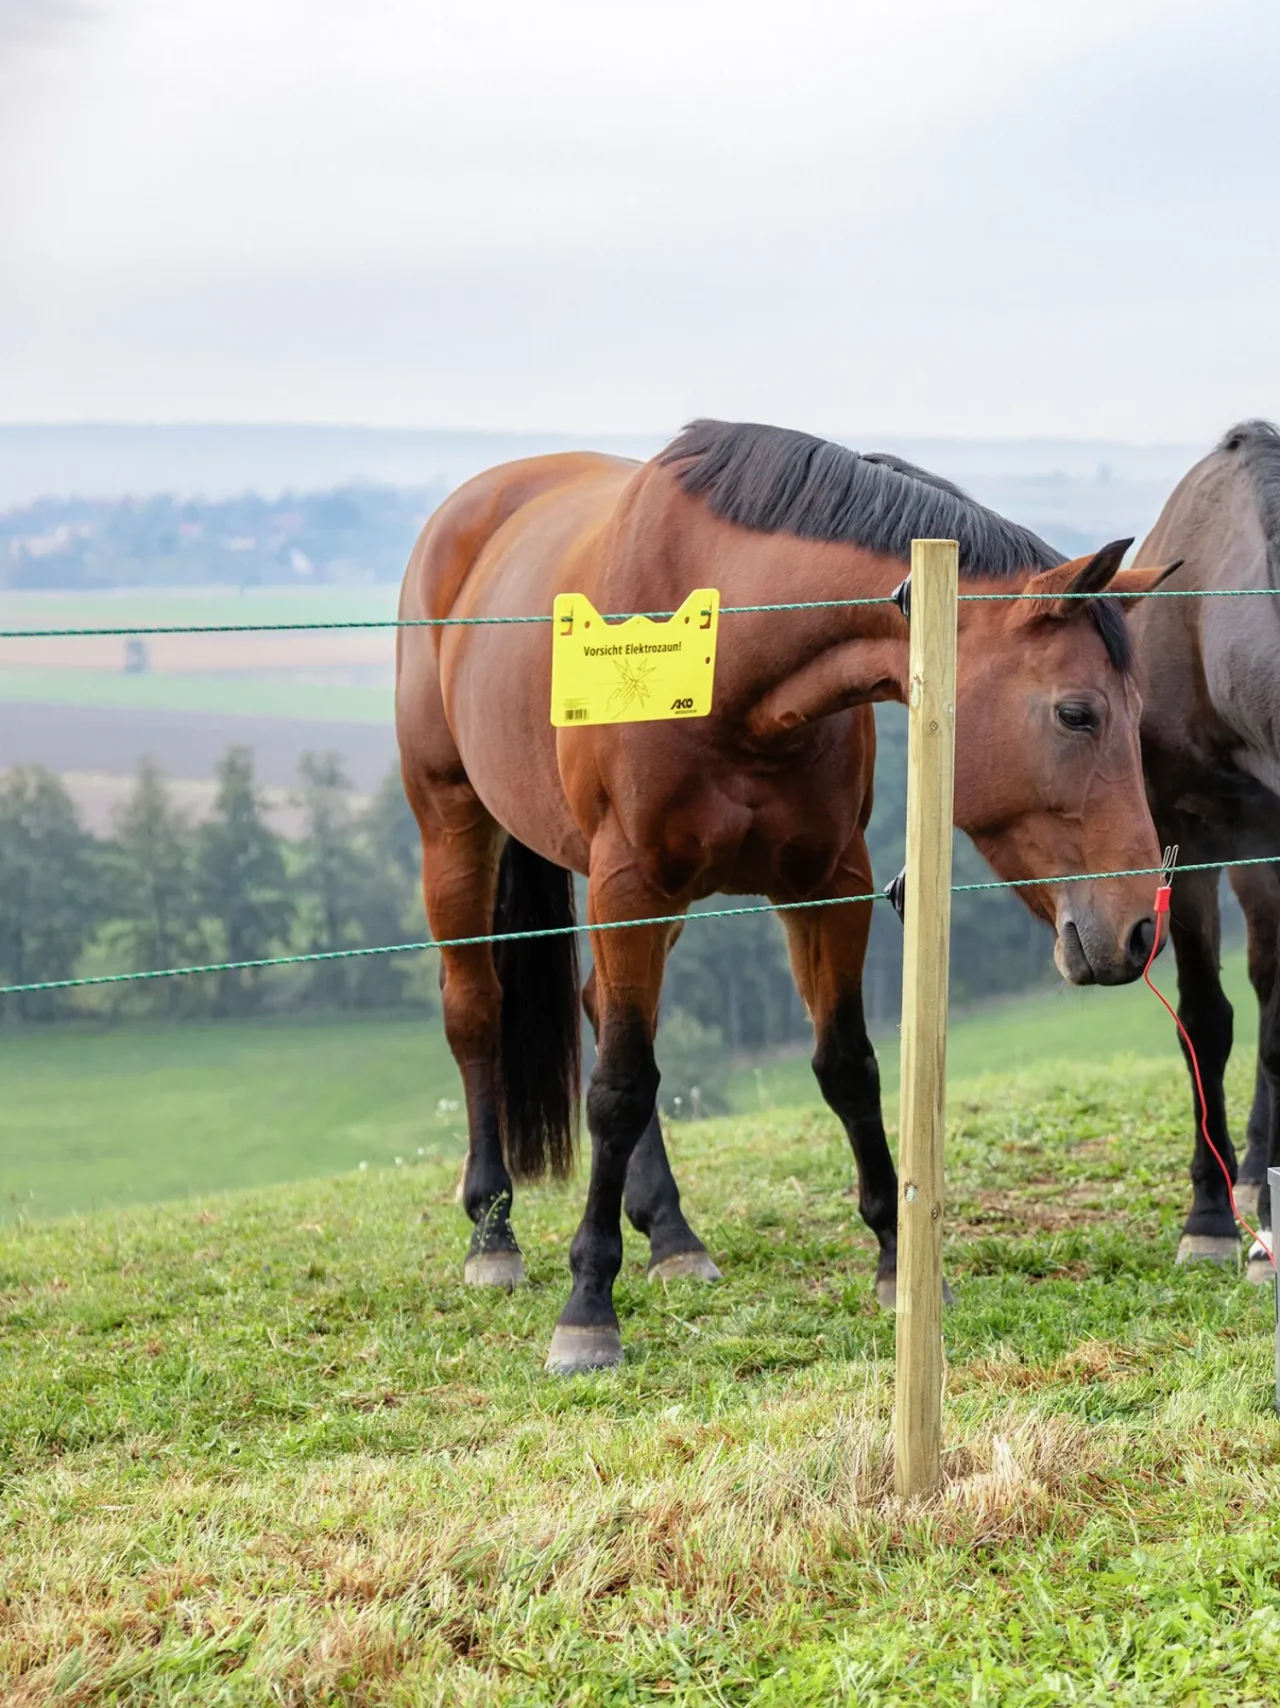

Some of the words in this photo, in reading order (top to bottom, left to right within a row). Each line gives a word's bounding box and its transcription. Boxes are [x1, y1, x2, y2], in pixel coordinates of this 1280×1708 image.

[584, 645, 622, 657] Vorsicht
[625, 641, 682, 655] Elektrozaun!
[670, 698, 694, 709] AKO
